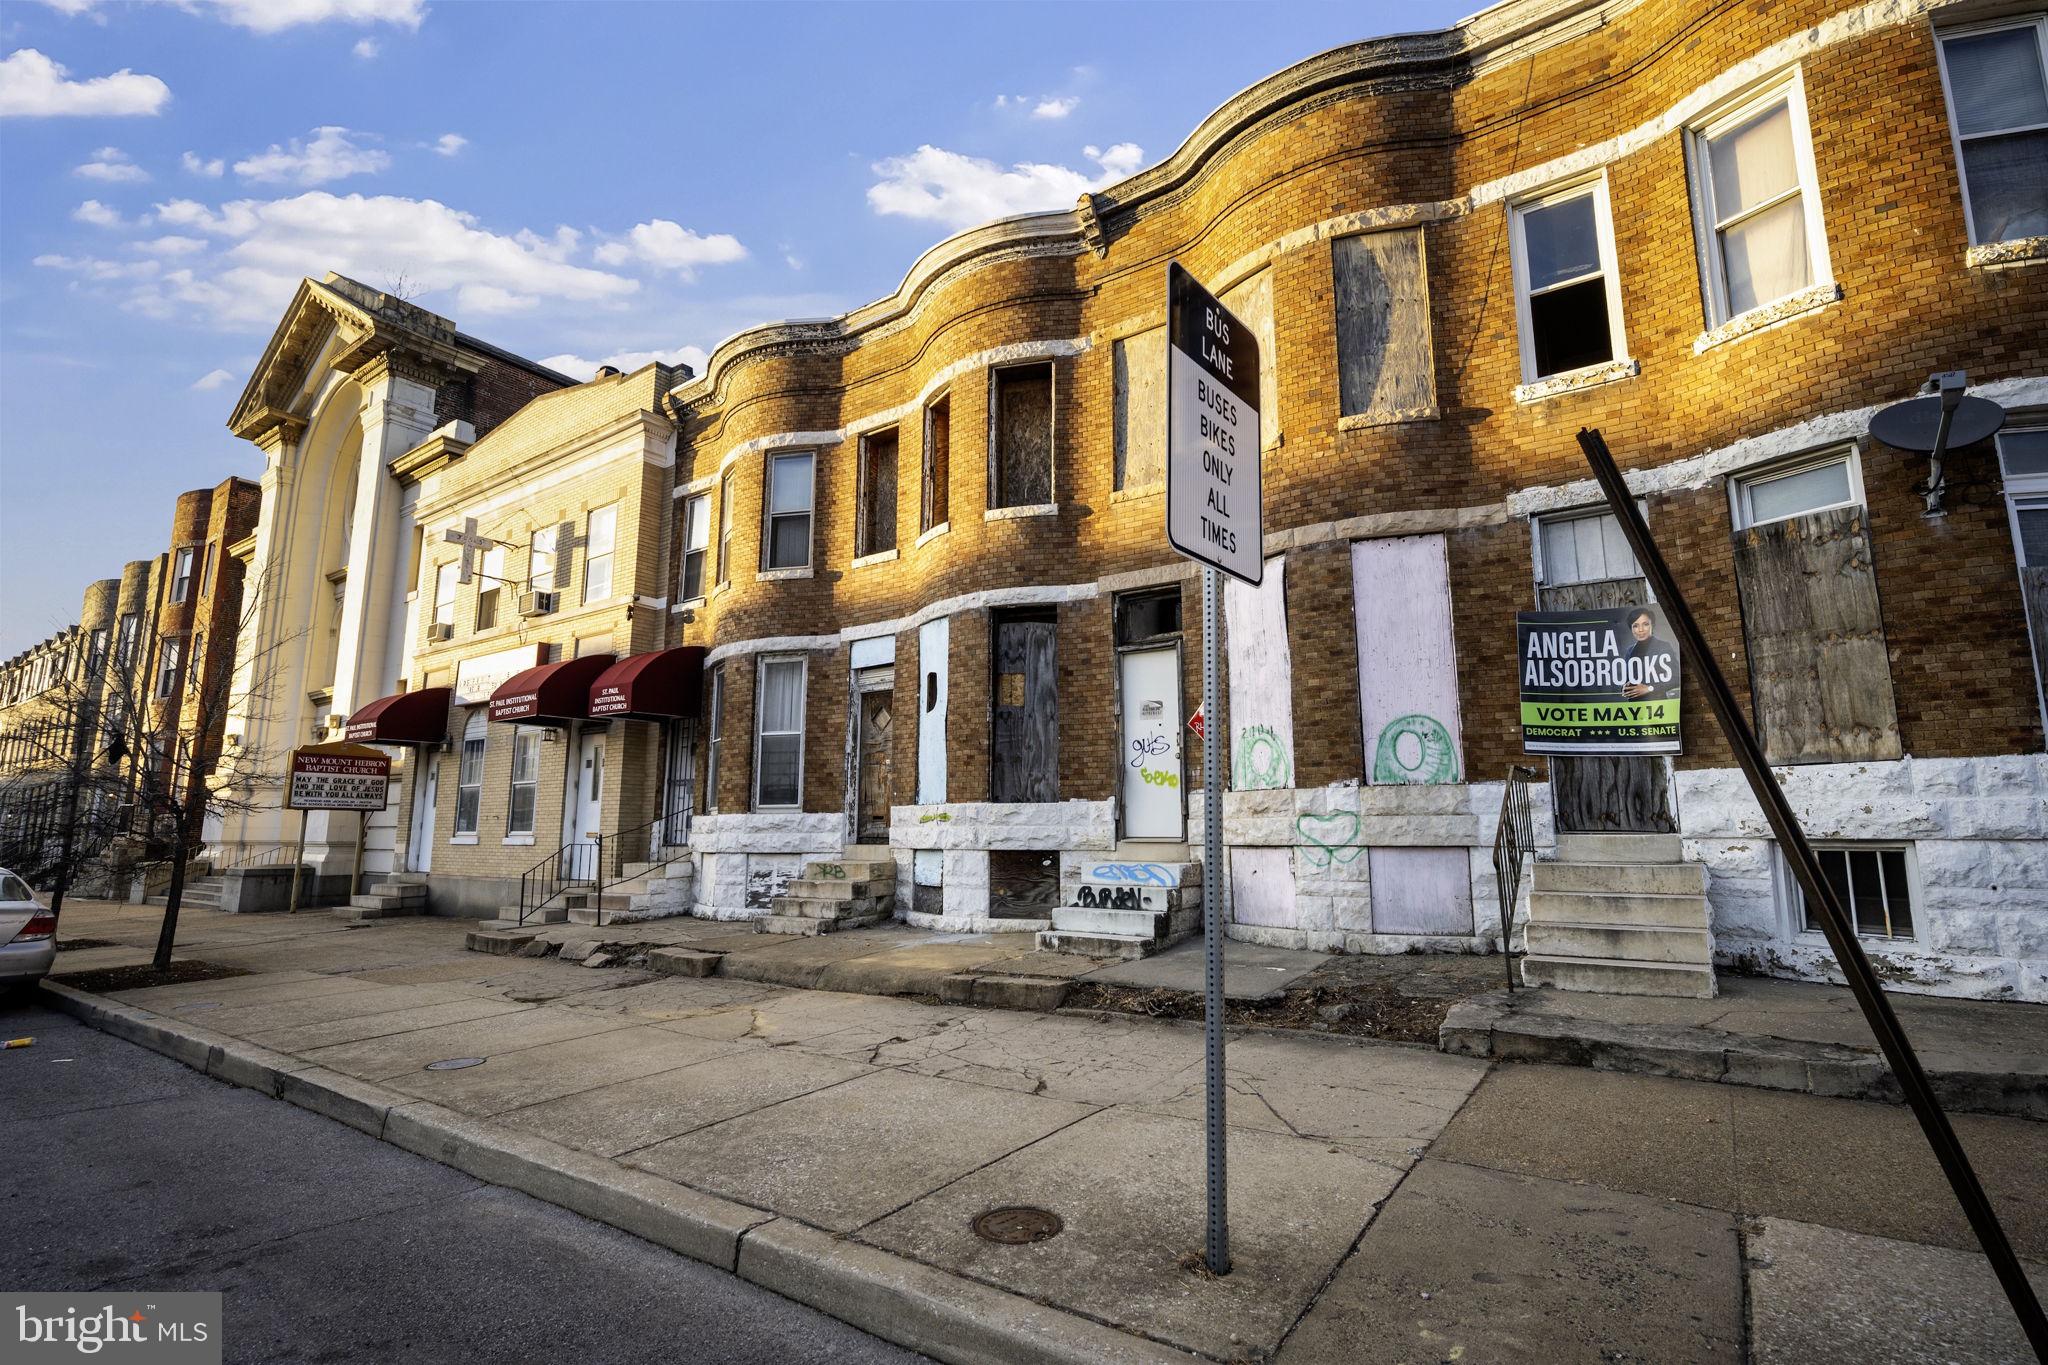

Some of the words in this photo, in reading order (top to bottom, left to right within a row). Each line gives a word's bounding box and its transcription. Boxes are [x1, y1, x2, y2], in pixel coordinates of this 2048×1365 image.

[1206, 306, 1230, 346] BUS
[1202, 335, 1234, 380] LANE
[1198, 379, 1237, 427] BUSES
[1200, 414, 1235, 457] BIKES
[1203, 450, 1233, 486] ONLY
[1207, 488, 1230, 518] ALL
[1201, 516, 1236, 554] TIMES
[1527, 629, 1620, 659] ANGELA
[1524, 653, 1673, 687] ALSOBROOKS
[495, 707, 512, 717] BAPTIST
[511, 704, 530, 714] CHURCH
[506, 694, 537, 704] INSTITUTIONAL
[592, 704, 610, 713] BAPTIST
[609, 702, 628, 711] CHURCH
[1537, 707, 1588, 721] VOTE
[1593, 706, 1642, 721] MAY
[1645, 704, 1665, 720] 14
[1526, 727, 1582, 737] DEMOCRAT
[1618, 728, 1639, 736] U.S.
[1641, 725, 1677, 735] SENATE
[298, 756, 318, 764] NEW
[321, 757, 352, 766] MOUNT
[355, 759, 386, 767] HEBRON
[343, 766, 377, 774] CHURCH
[316, 776, 330, 784] THE
[332, 777, 356, 785] GRACE
